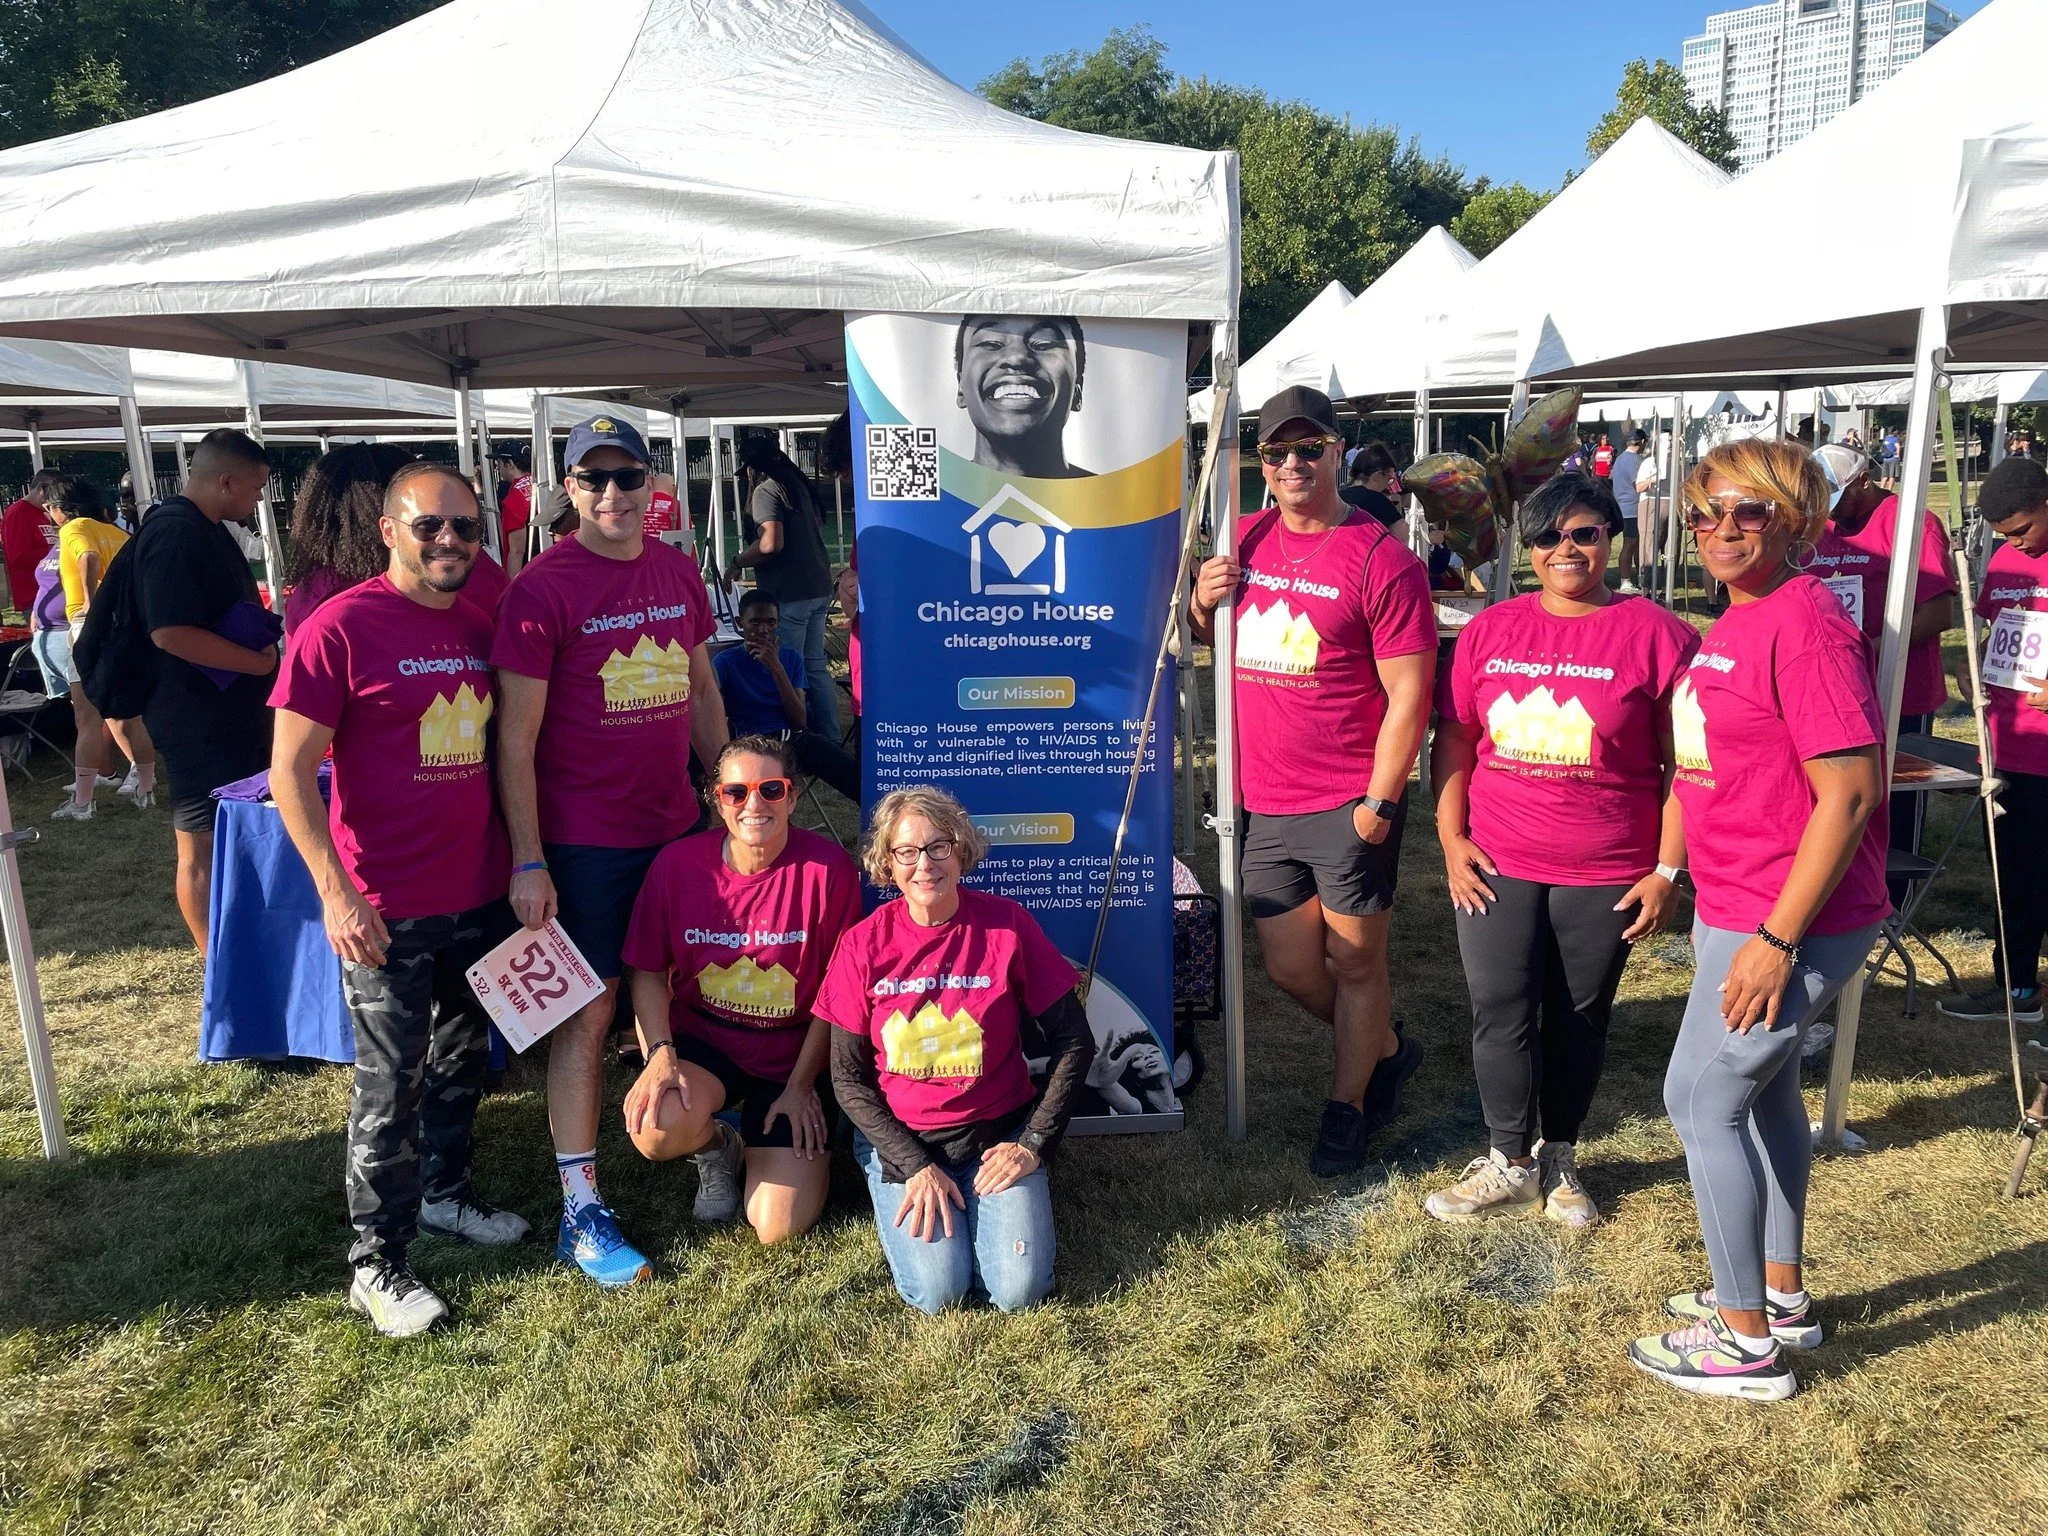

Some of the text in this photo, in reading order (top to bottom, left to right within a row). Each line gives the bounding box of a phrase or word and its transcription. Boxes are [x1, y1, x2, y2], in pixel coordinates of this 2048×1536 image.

[1272, 563, 1310, 574] TEAM
[1291, 577, 1340, 600] House
[2028, 585, 2048, 599] Hou
[617, 595, 655, 607] TEAM
[581, 604, 687, 634] Chicago House
[917, 600, 1115, 626] Chicago House
[944, 632, 1092, 651] chicagohouse.org
[1527, 650, 1574, 659] TEAM
[398, 654, 492, 676] Chicago Hou
[1485, 657, 1615, 681] Chicago House
[1256, 675, 1264, 684] IS
[1265, 677, 1296, 688] HEALTH
[1297, 680, 1320, 689] CARE
[967, 685, 1066, 701] Our Mission
[600, 715, 643, 726] HOUSING
[645, 713, 653, 722] IS
[654, 709, 680, 721] HEALTH
[876, 722, 928, 736] Chicago
[937, 722, 978, 733] House
[986, 721, 1055, 735] empowers
[1063, 721, 1114, 733] persons
[876, 733, 1156, 748] with or vulnerable to HIV/AIDS to led
[876, 748, 1156, 765] healthy and dignified lives through housng
[413, 770, 468, 781] HOUSING IS
[876, 766, 900, 777] and
[903, 765, 1004, 779] compassionate,
[1006, 764, 1104, 775] client-centered
[1519, 767, 1529, 776] IS
[1529, 769, 1567, 779] HEALTH
[1569, 770, 1596, 779] CARE
[976, 822, 1059, 837] Our Vision
[977, 858, 1008, 869] aims
[1011, 858, 1025, 868] to
[1028, 856, 1055, 869] play
[1058, 858, 1066, 866] a
[1069, 855, 1112, 866] critical
[1143, 854, 1154, 865] in
[990, 871, 1053, 882] infections
[1058, 870, 1083, 880] and
[1088, 869, 1136, 881] Geting
[1142, 869, 1154, 879] to
[1000, 885, 1051, 896] believes
[1056, 884, 1083, 894] that
[1088, 883, 1139, 895] hosing
[1144, 881, 1155, 893] is
[1026, 897, 1083, 910] HIV/AIDS
[684, 928, 808, 949] Chicago House
[911, 962, 952, 971] TEAM
[509, 941, 570, 1011] 522
[473, 976, 491, 998] 522
[873, 973, 992, 996] Chicago House
[498, 973, 513, 992] 5K
[507, 988, 530, 1015] RUN
